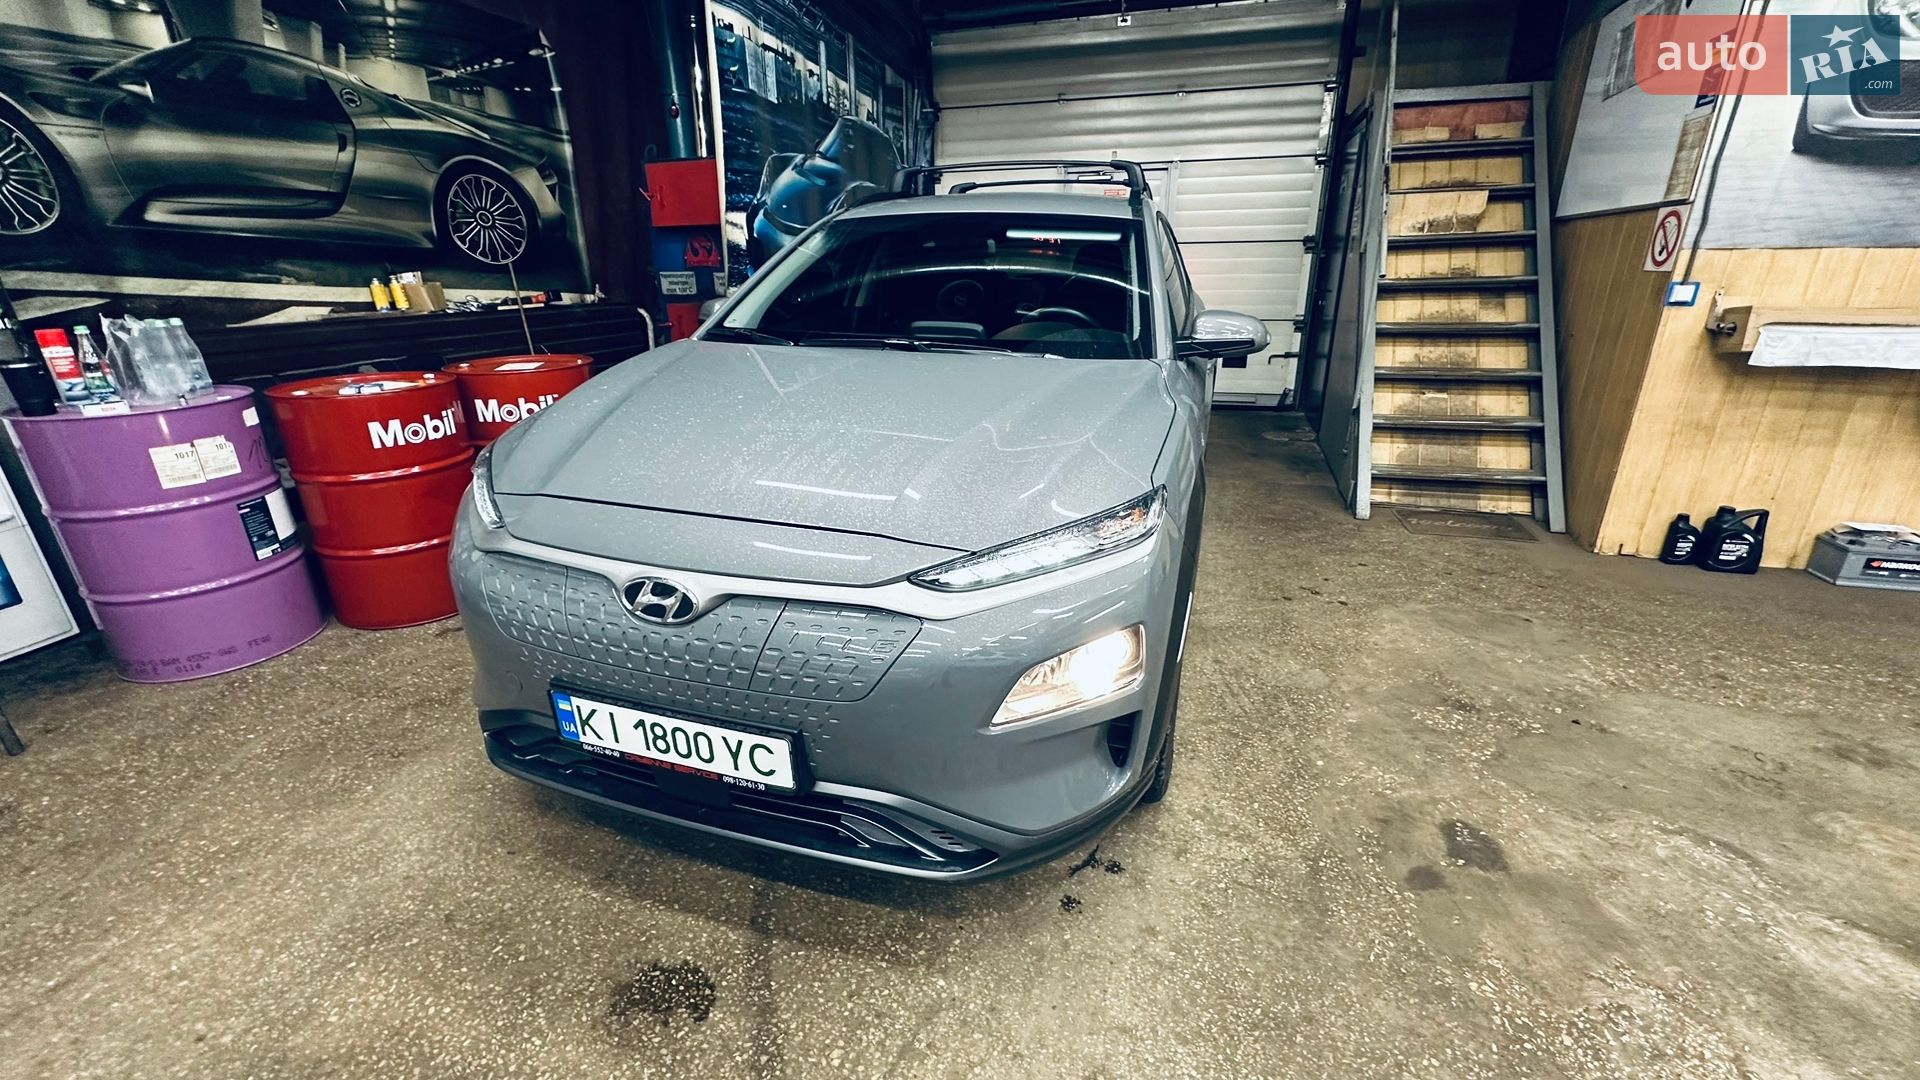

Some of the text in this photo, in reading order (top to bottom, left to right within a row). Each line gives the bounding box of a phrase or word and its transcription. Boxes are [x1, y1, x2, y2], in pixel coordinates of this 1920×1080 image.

[367, 407, 457, 449] Mobil
[562, 704, 777, 777] UA KI 1800 YC
[674, 765, 719, 781] SERVICE
